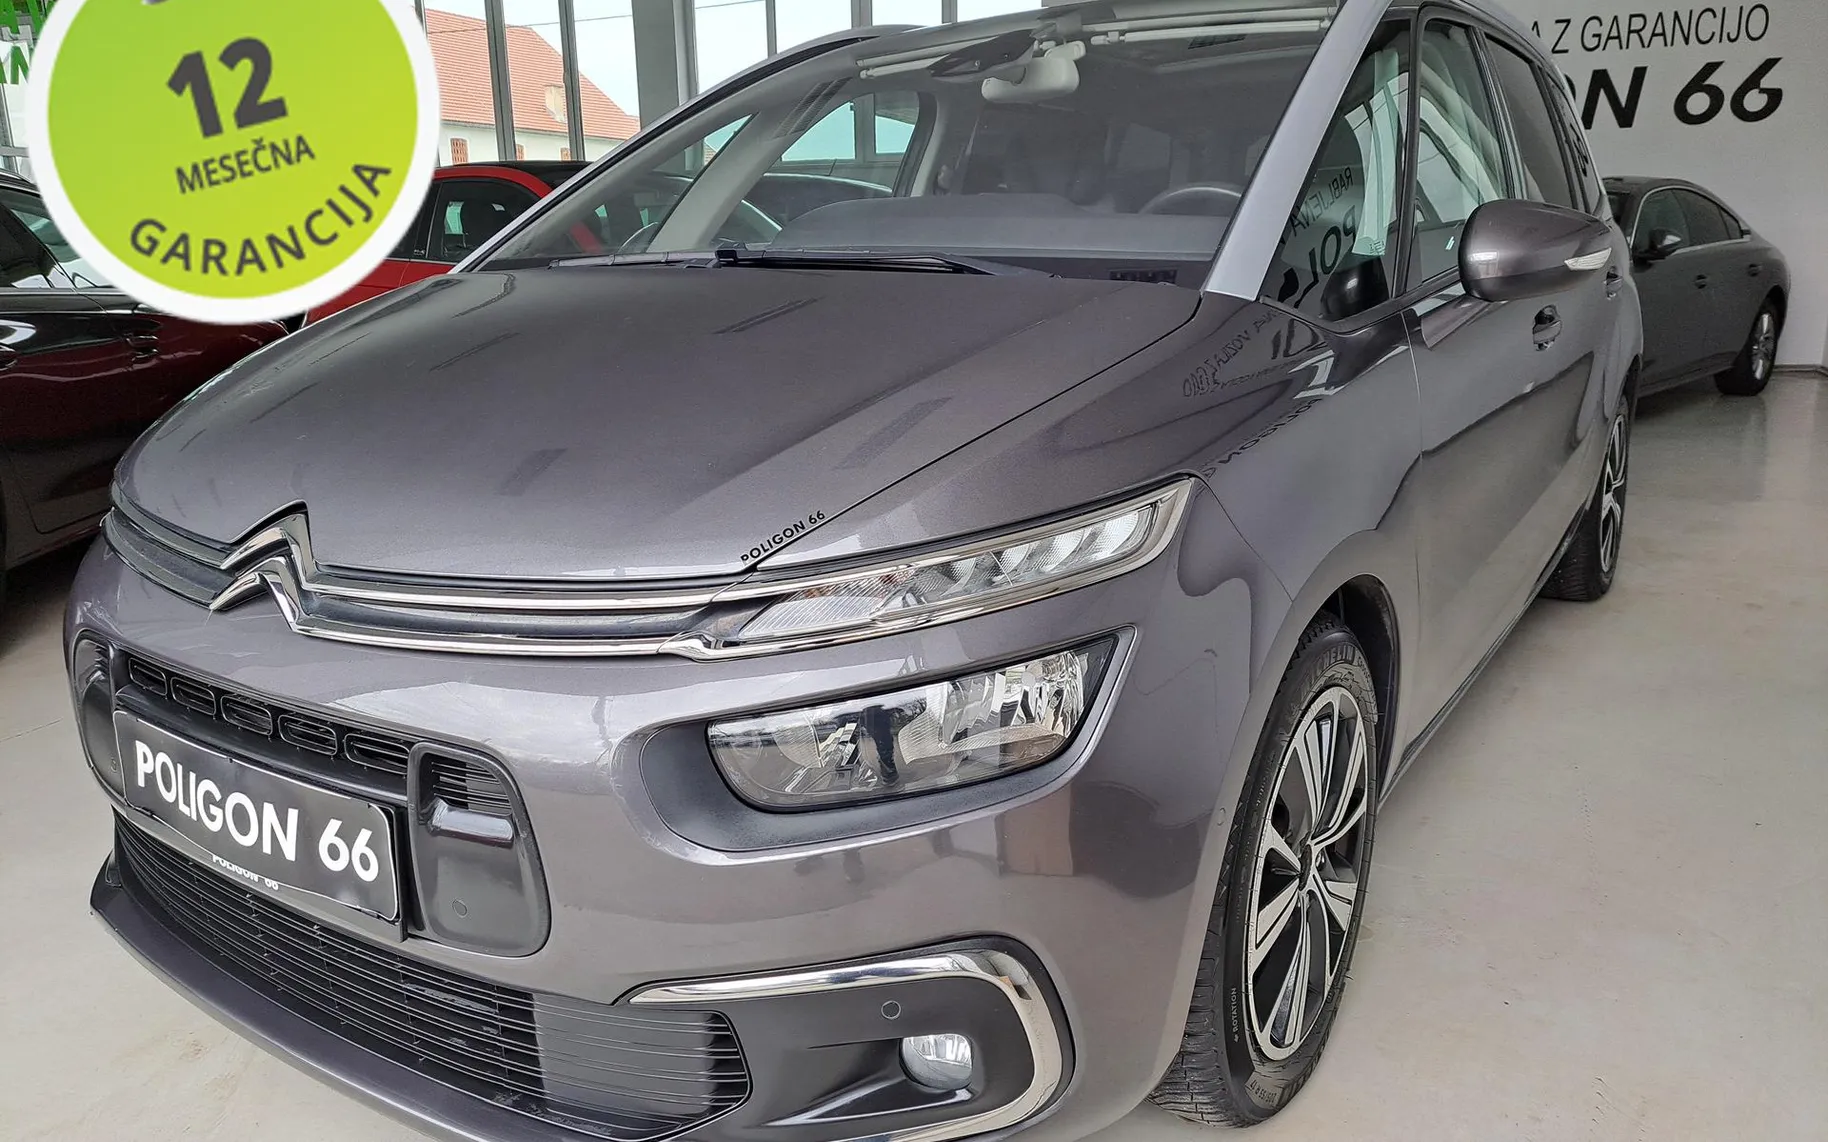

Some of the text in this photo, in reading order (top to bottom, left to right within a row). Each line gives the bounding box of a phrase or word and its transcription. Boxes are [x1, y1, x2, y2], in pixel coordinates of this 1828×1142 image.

[1551, 19, 1571, 54] Z
[1581, 3, 1770, 52] GARANCIJO
[1673, 57, 1784, 125] 66
[740, 510, 825, 564] POLIGON 66
[135, 740, 379, 882] POLIGON 66
[1230, 987, 1239, 1033] ROTATION
